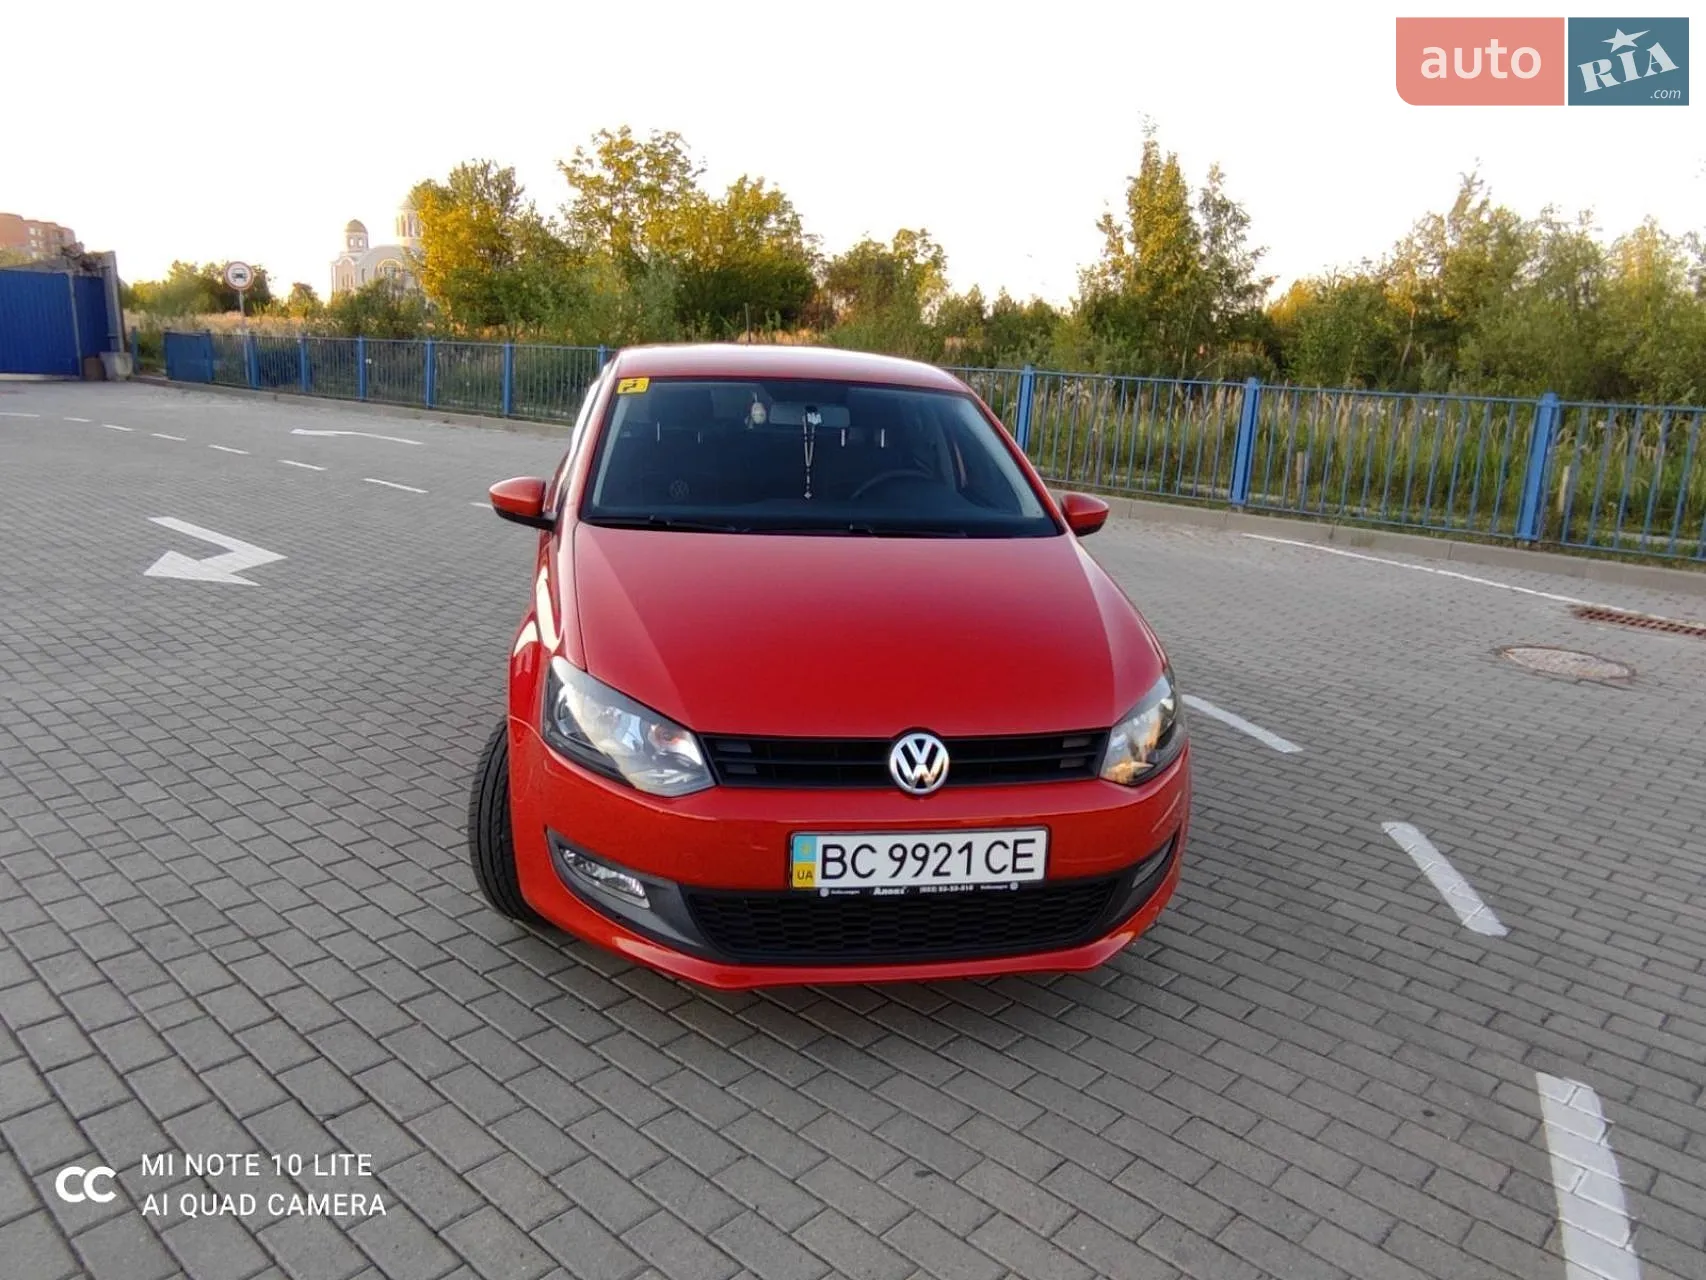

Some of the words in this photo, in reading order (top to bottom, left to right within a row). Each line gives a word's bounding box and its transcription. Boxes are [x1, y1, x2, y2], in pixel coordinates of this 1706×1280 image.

[820, 843, 877, 880] BC
[888, 840, 974, 878] 9921
[984, 838, 1036, 875] CE
[796, 870, 814, 881] UA
